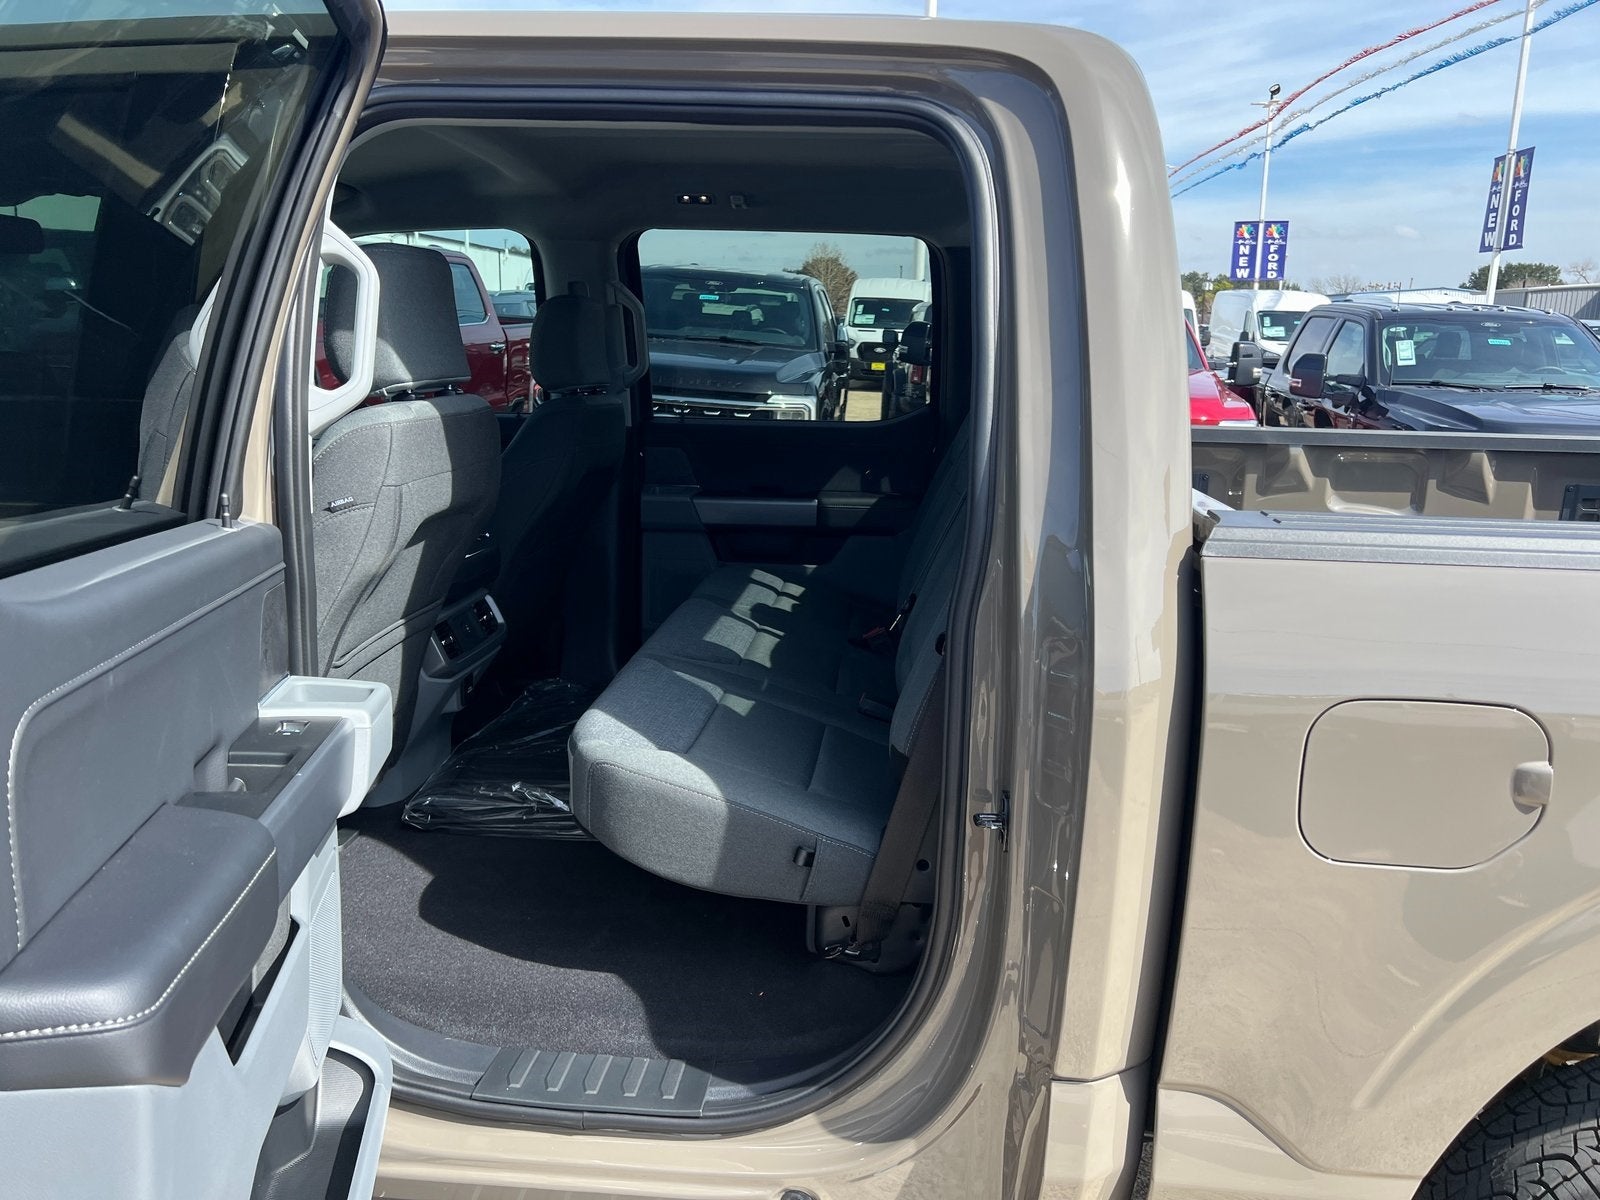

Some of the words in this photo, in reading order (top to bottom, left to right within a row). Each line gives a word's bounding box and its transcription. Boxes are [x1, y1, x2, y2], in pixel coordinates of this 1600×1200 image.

[1484, 193, 1500, 247] NEW
[1508, 189, 1522, 246] FORD
[1235, 244, 1250, 279] NEW
[1266, 244, 1279, 279] FORD
[330, 496, 354, 508] AIRBAG
